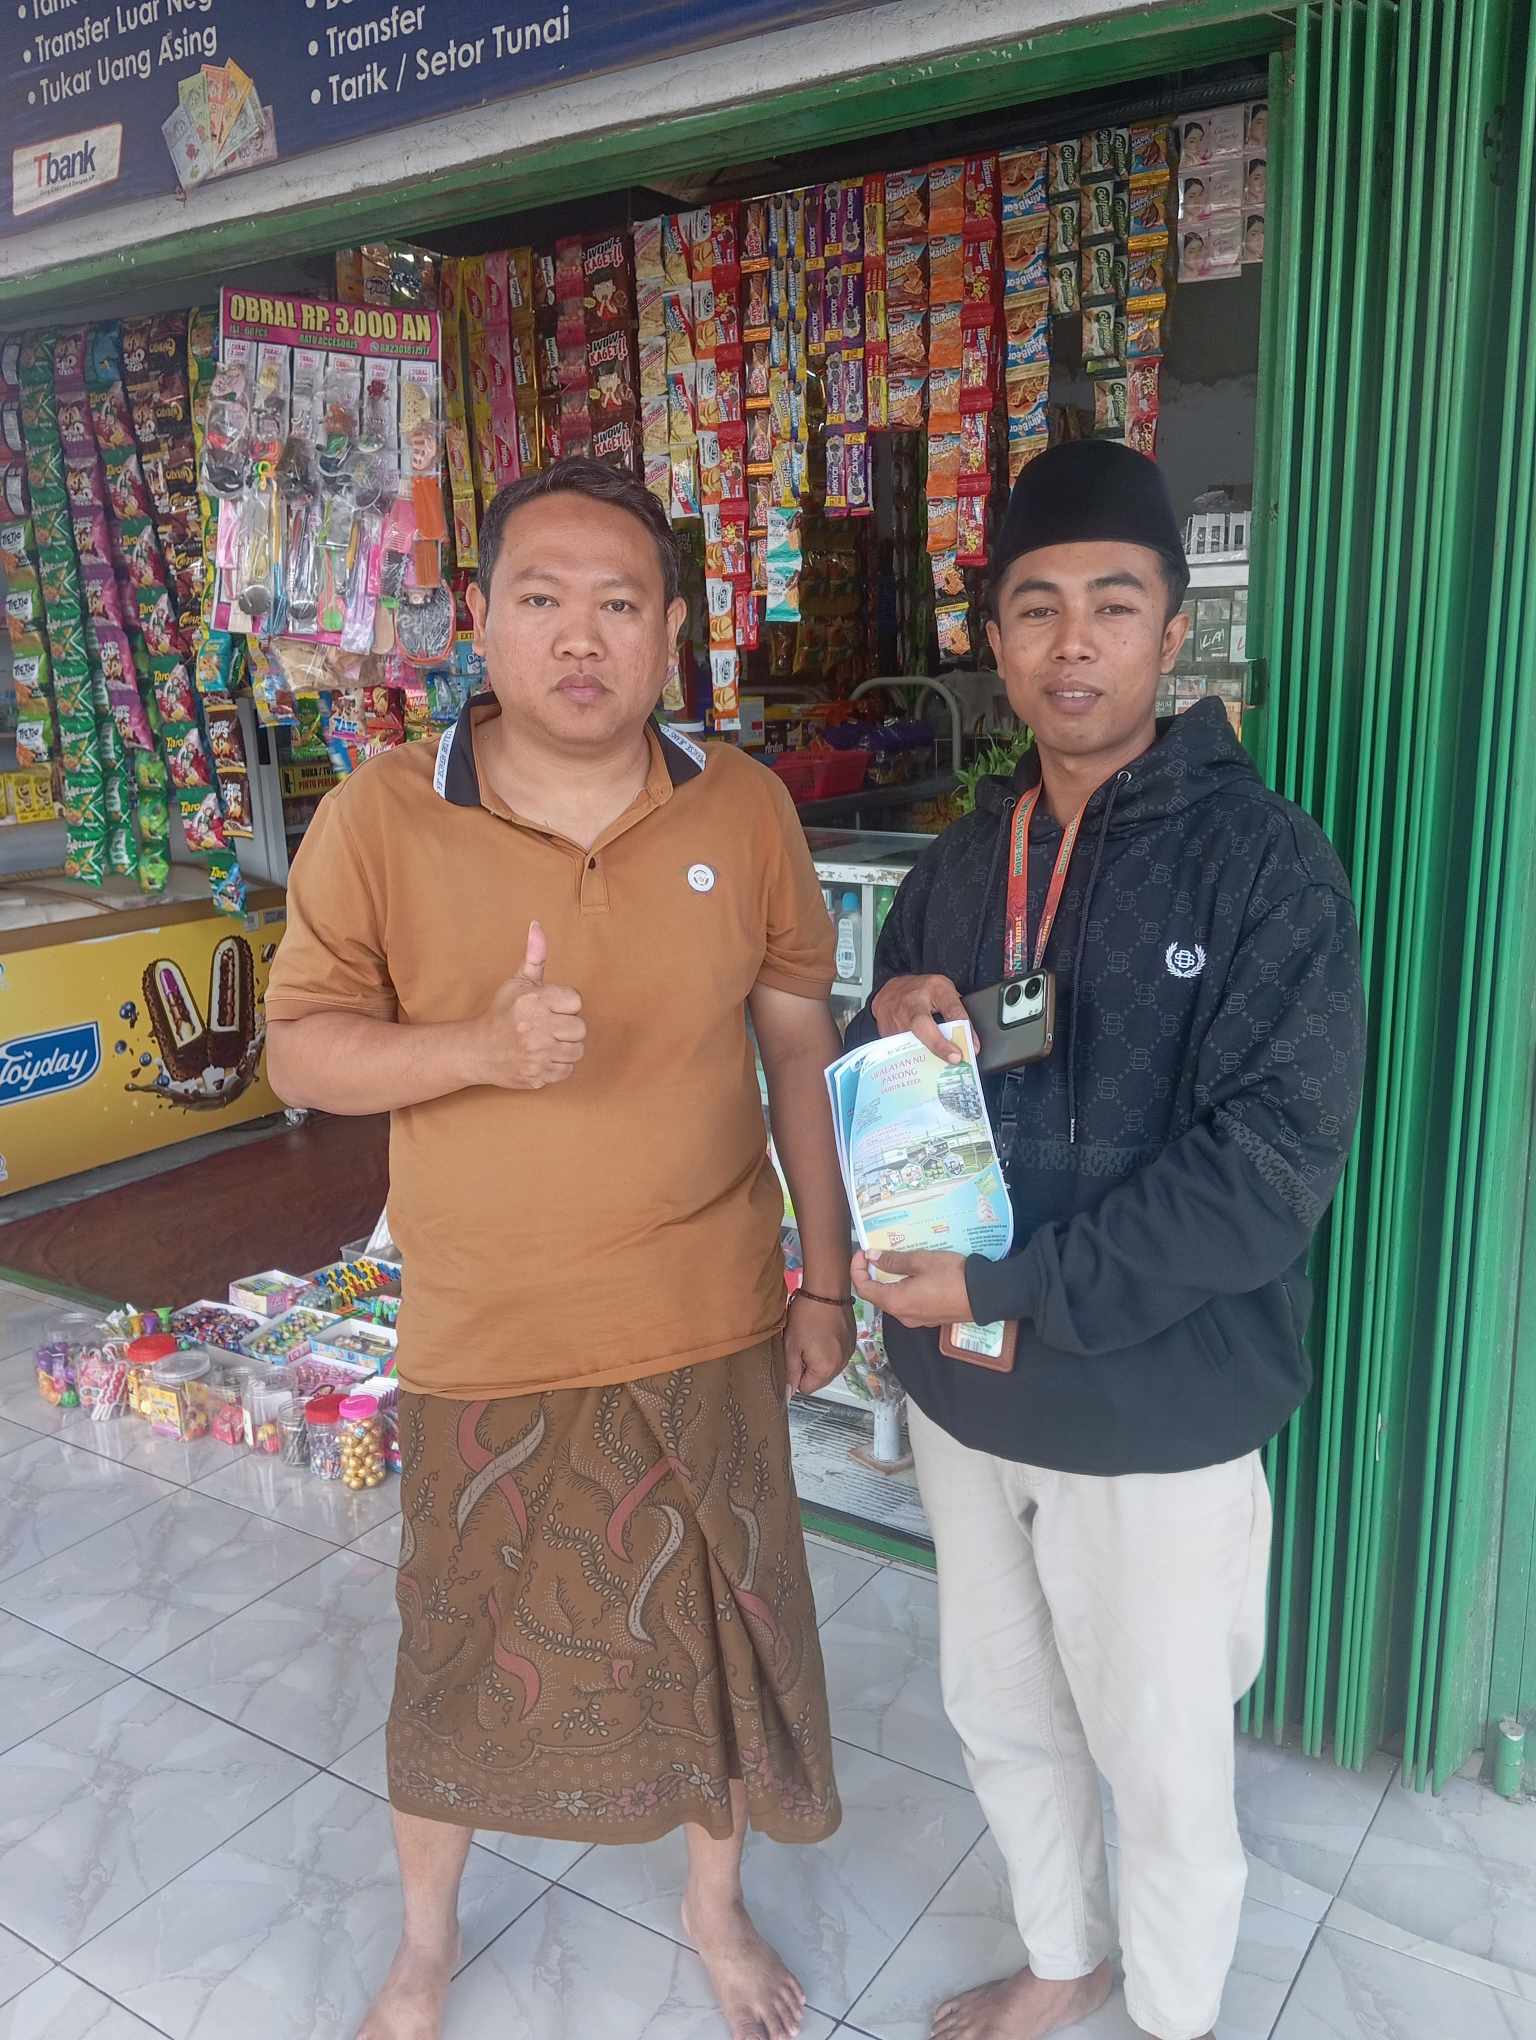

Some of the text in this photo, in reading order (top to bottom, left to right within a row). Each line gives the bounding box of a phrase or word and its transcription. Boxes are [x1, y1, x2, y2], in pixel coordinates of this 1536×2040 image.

[35, 15, 110, 63] Transfer
[116, 2, 160, 34] Luar
[326, 7, 425, 58] Transfer
[328, 12, 571, 105] Tarik / Setor Tunai
[40, 25, 217, 106] Tukar Uang Asing
[33, 140, 96, 187] Tbank
[230, 294, 431, 342] OBRAL RP. 3.000 AN
